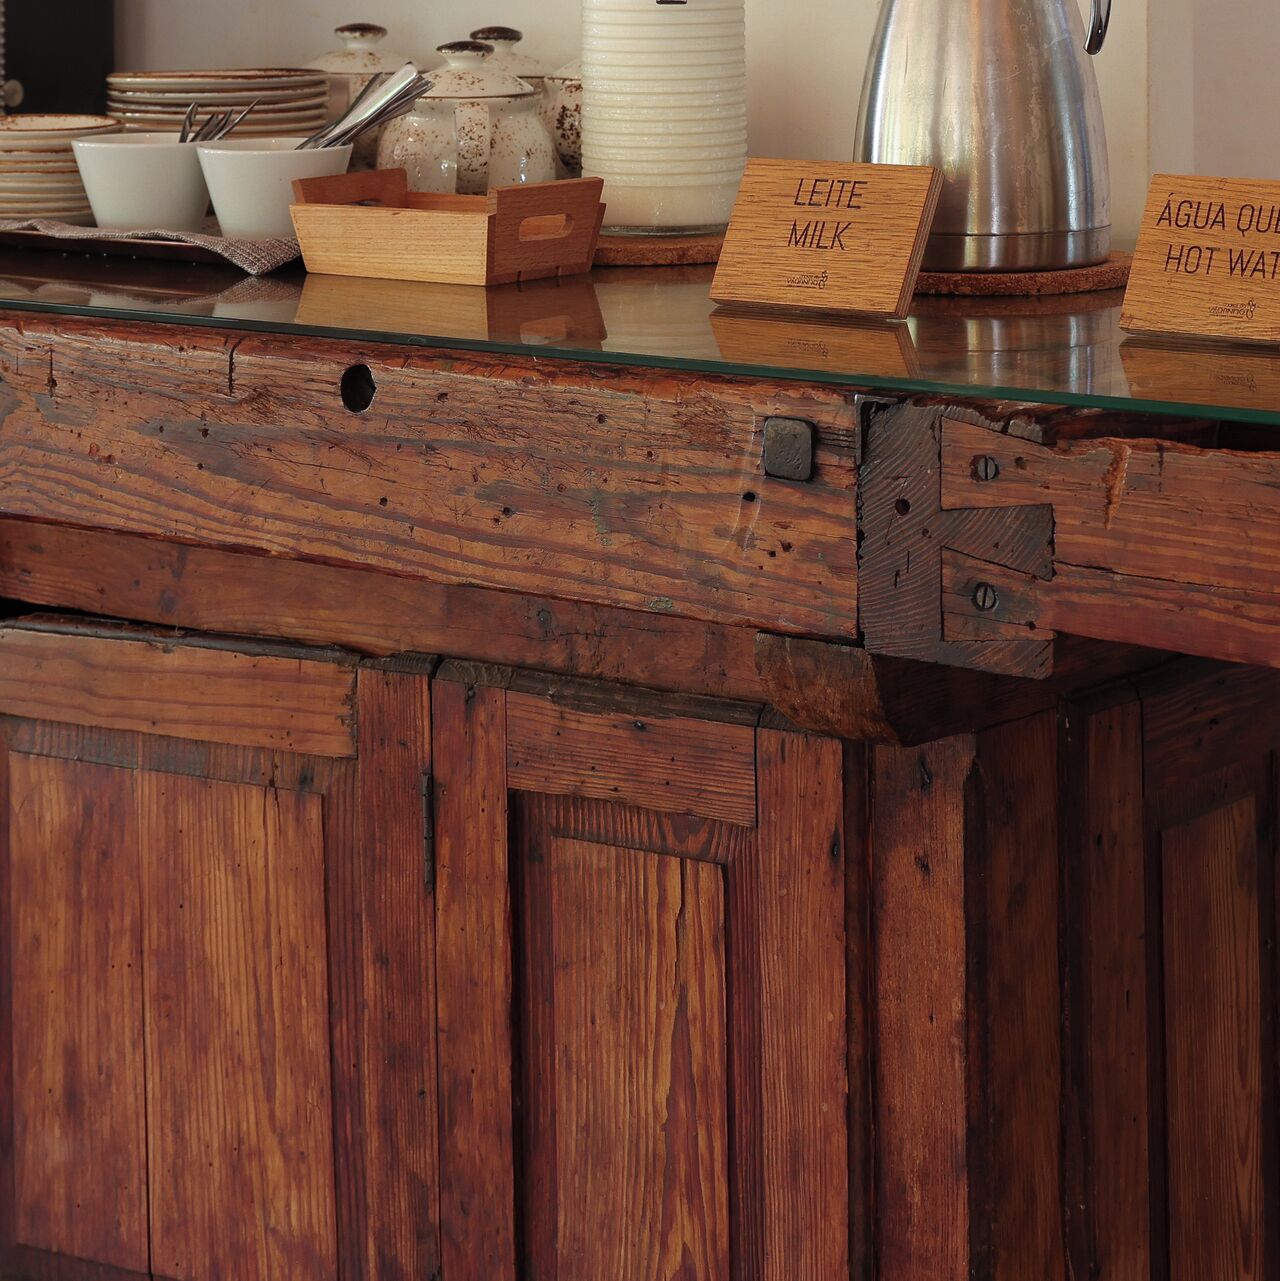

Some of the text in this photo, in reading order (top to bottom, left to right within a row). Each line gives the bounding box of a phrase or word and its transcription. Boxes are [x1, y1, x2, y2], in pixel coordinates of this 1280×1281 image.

[794, 178, 867, 209] LEITE
[1156, 192, 1226, 230] ÁGUA
[787, 219, 852, 250] MILK
[1164, 244, 1221, 275] HOT
